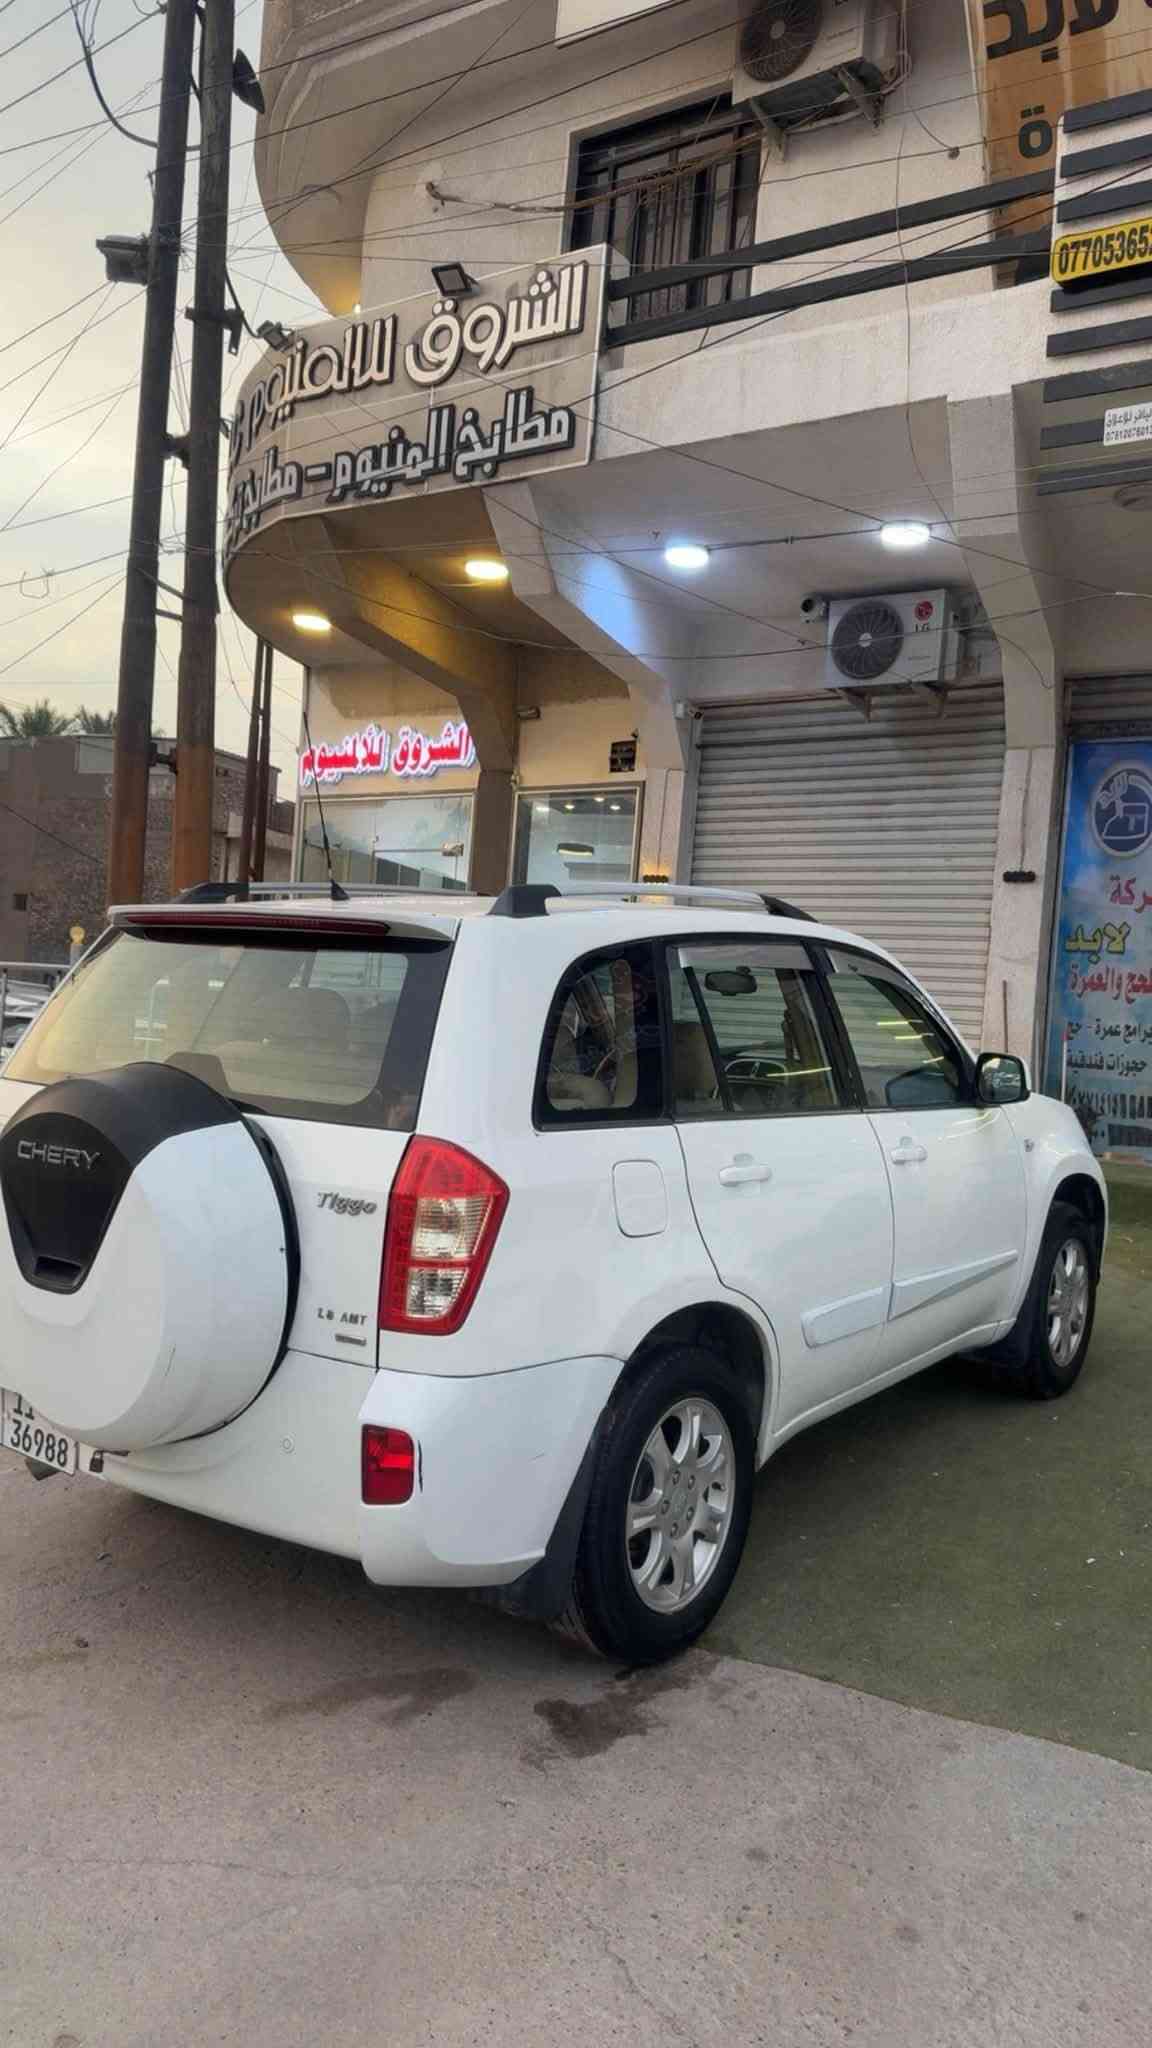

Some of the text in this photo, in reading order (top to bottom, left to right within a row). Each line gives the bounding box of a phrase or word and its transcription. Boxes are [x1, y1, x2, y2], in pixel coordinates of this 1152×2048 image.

[404, 260, 590, 387] الشروق
[326, 403, 456, 502] المنيوم
[453, 385, 576, 483] مطابخ
[1109, 874, 1152, 914] ركة
[1065, 921, 1131, 965] لابد
[17, 1139, 101, 1170] CHERY
[317, 1191, 377, 1216] Tiggo
[339, 1312, 368, 1326] AMT
[10, 1418, 68, 1468] 36988
